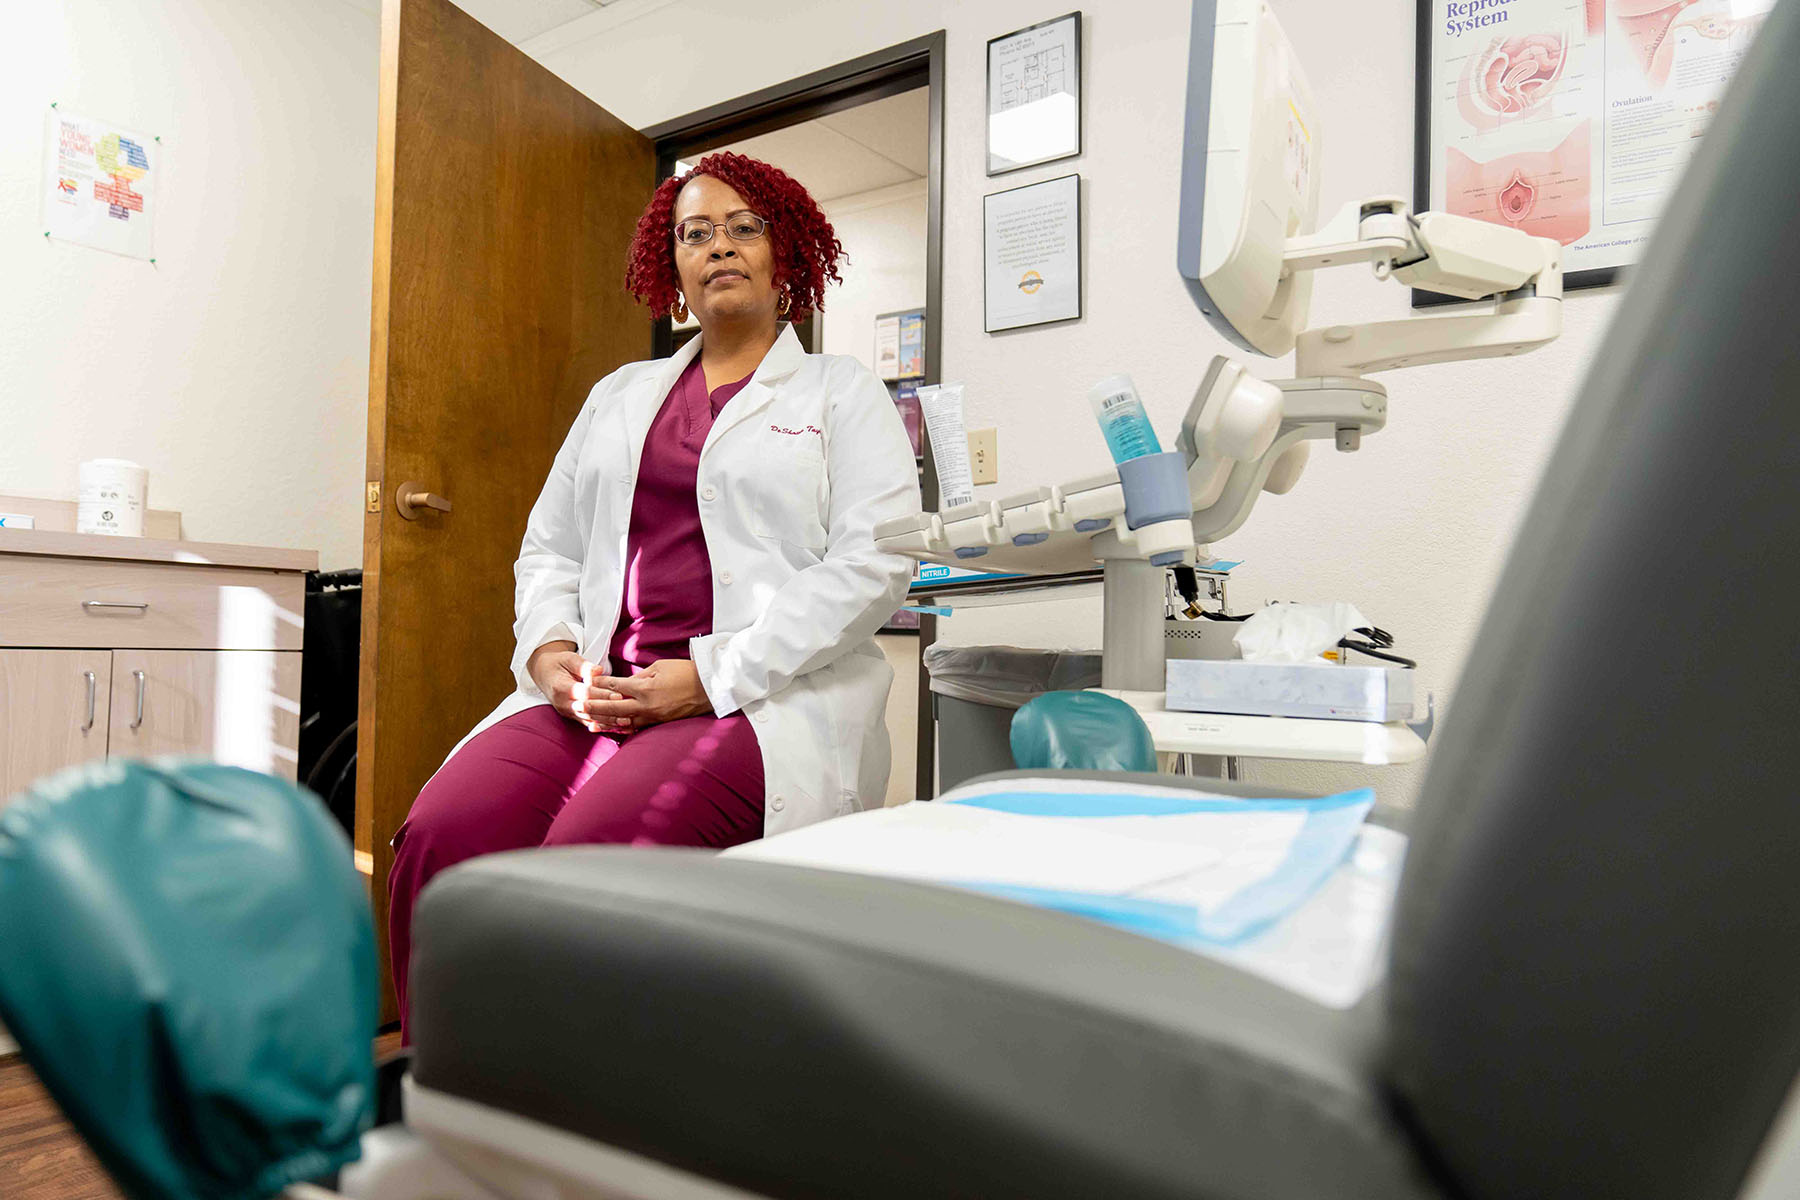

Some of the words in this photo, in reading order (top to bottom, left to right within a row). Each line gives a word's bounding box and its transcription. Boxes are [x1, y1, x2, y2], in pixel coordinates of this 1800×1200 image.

[1446, 10, 1508, 37] System
[1611, 96, 1653, 108] Ovulation
[1585, 241, 1610, 250] American
[1611, 239, 1631, 247] College
[922, 568, 948, 578] NITRILE
